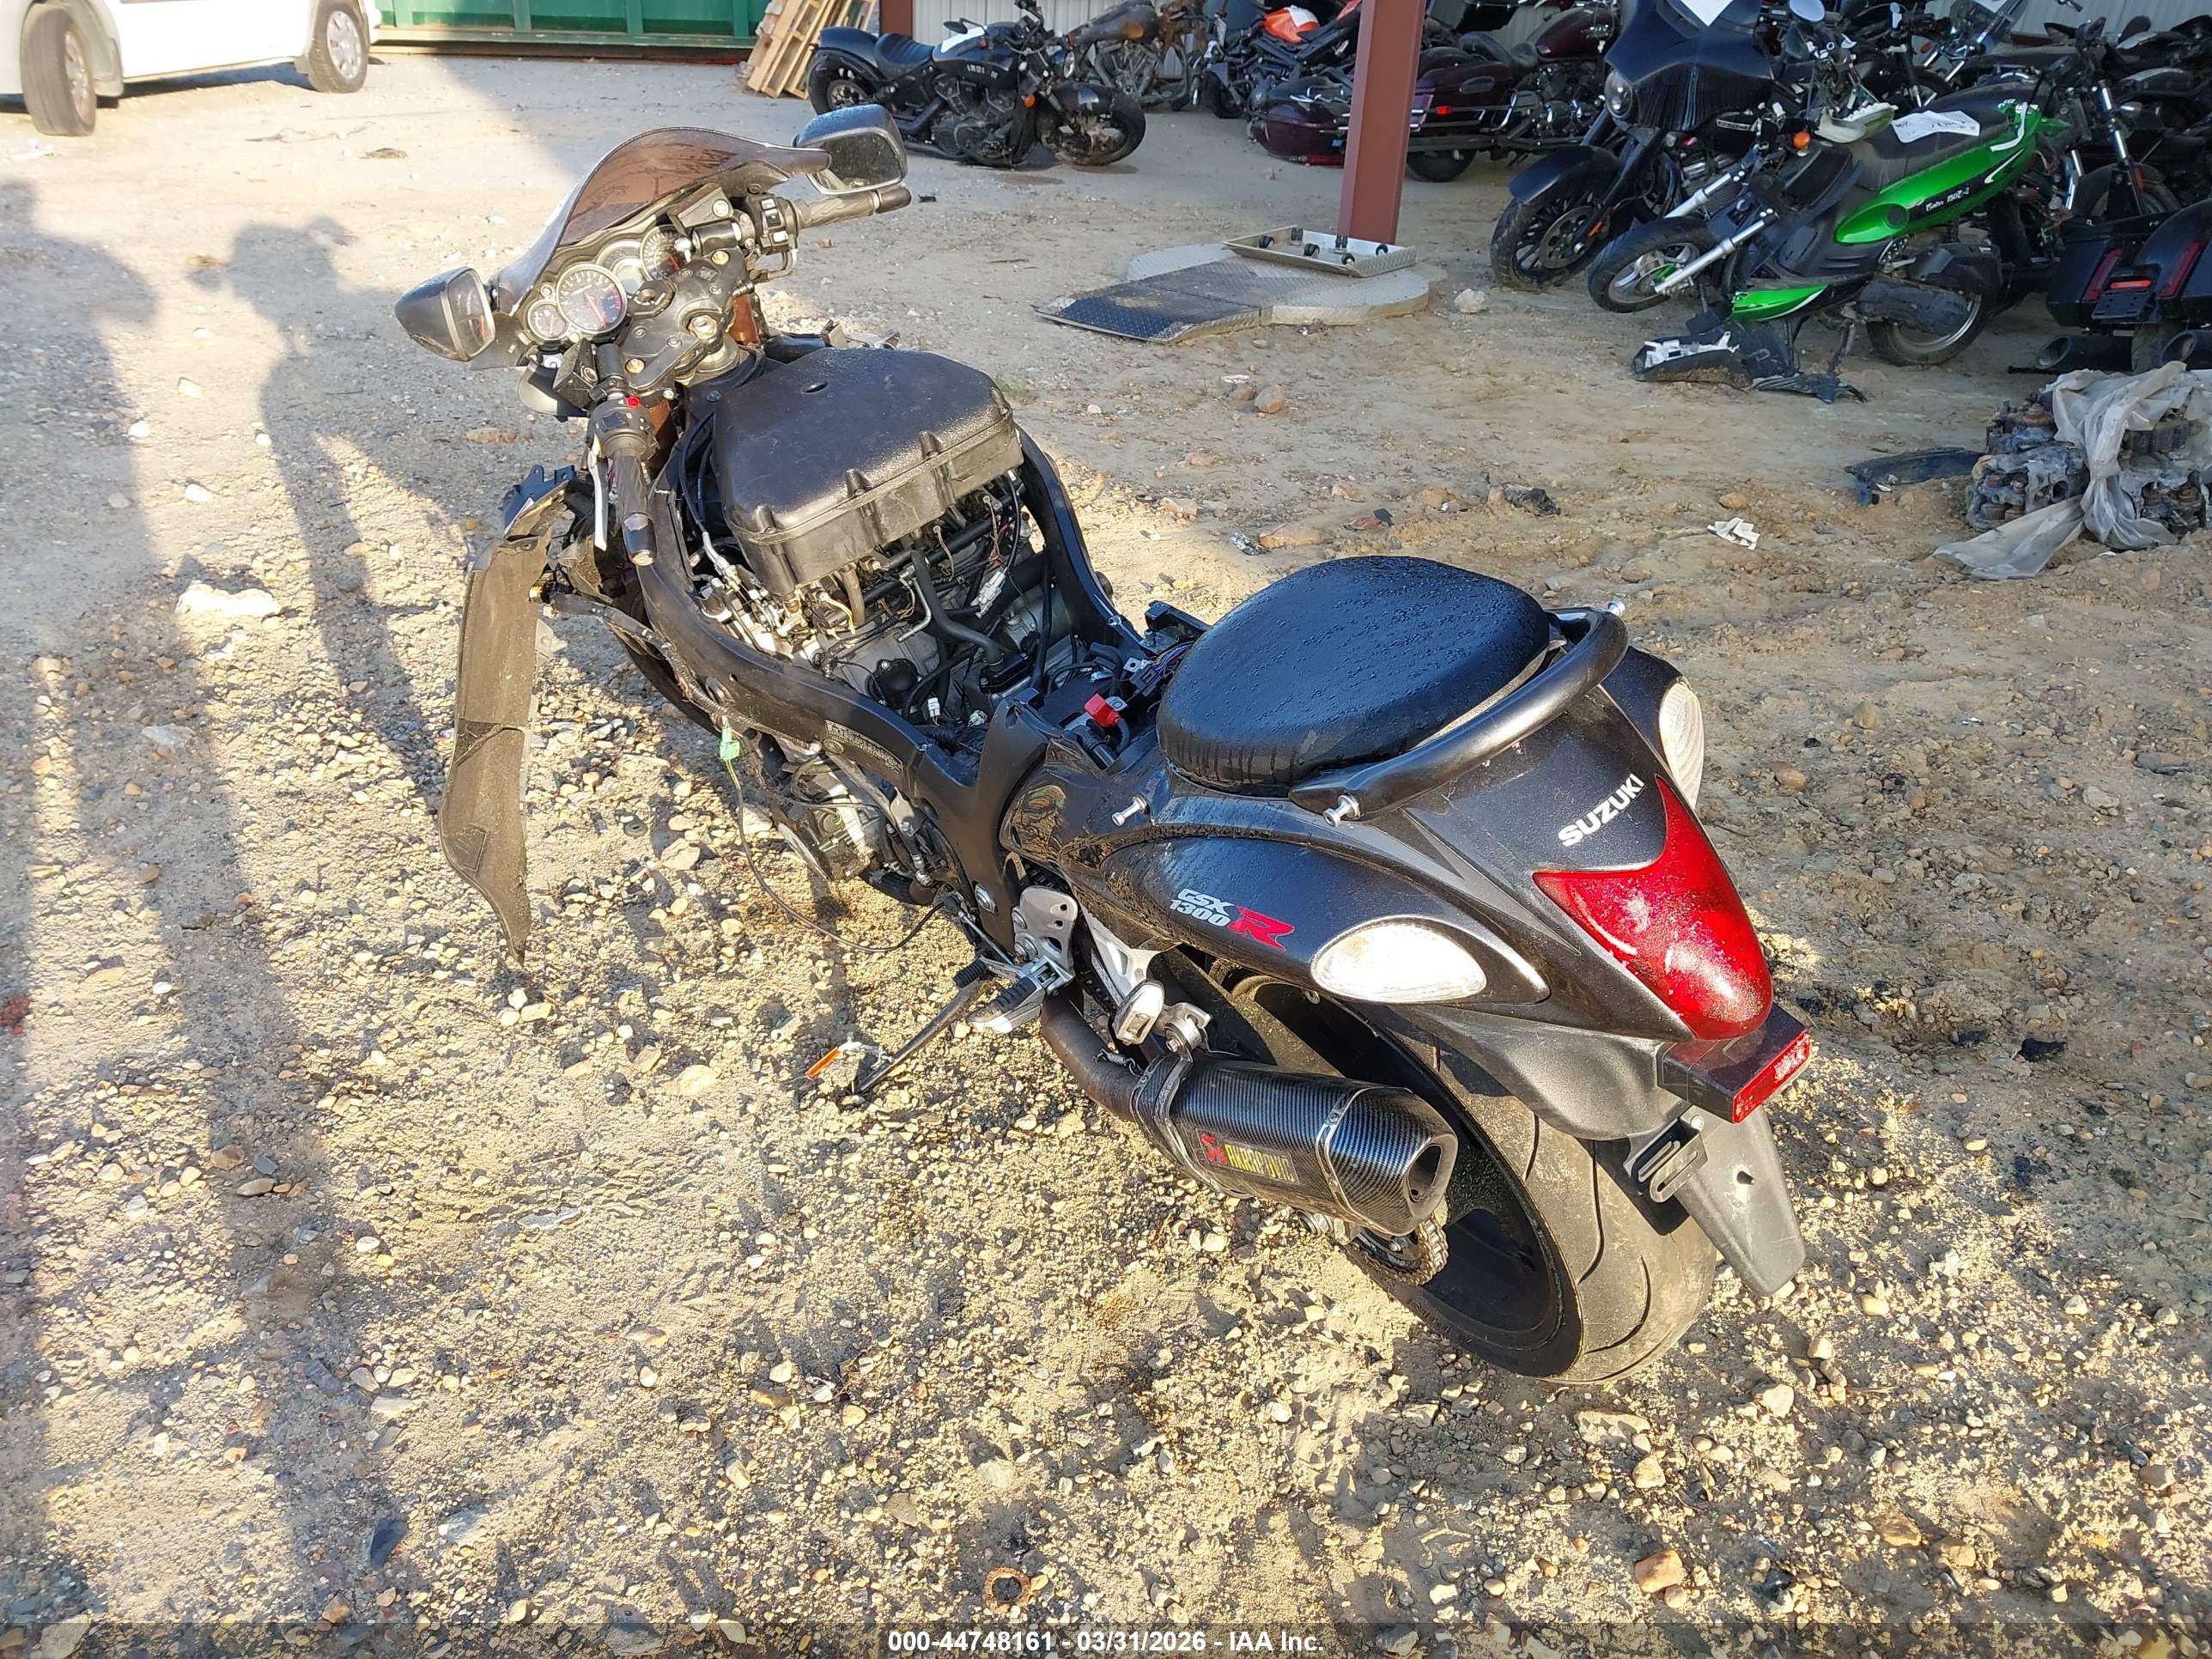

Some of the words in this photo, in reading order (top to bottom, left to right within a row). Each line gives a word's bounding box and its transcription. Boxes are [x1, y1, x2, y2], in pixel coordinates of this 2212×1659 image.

[1558, 773, 1645, 847] SUZUKI
[1169, 899, 1231, 927] 1300
[1227, 906, 1296, 951] R
[1177, 888, 1235, 916] GSX
